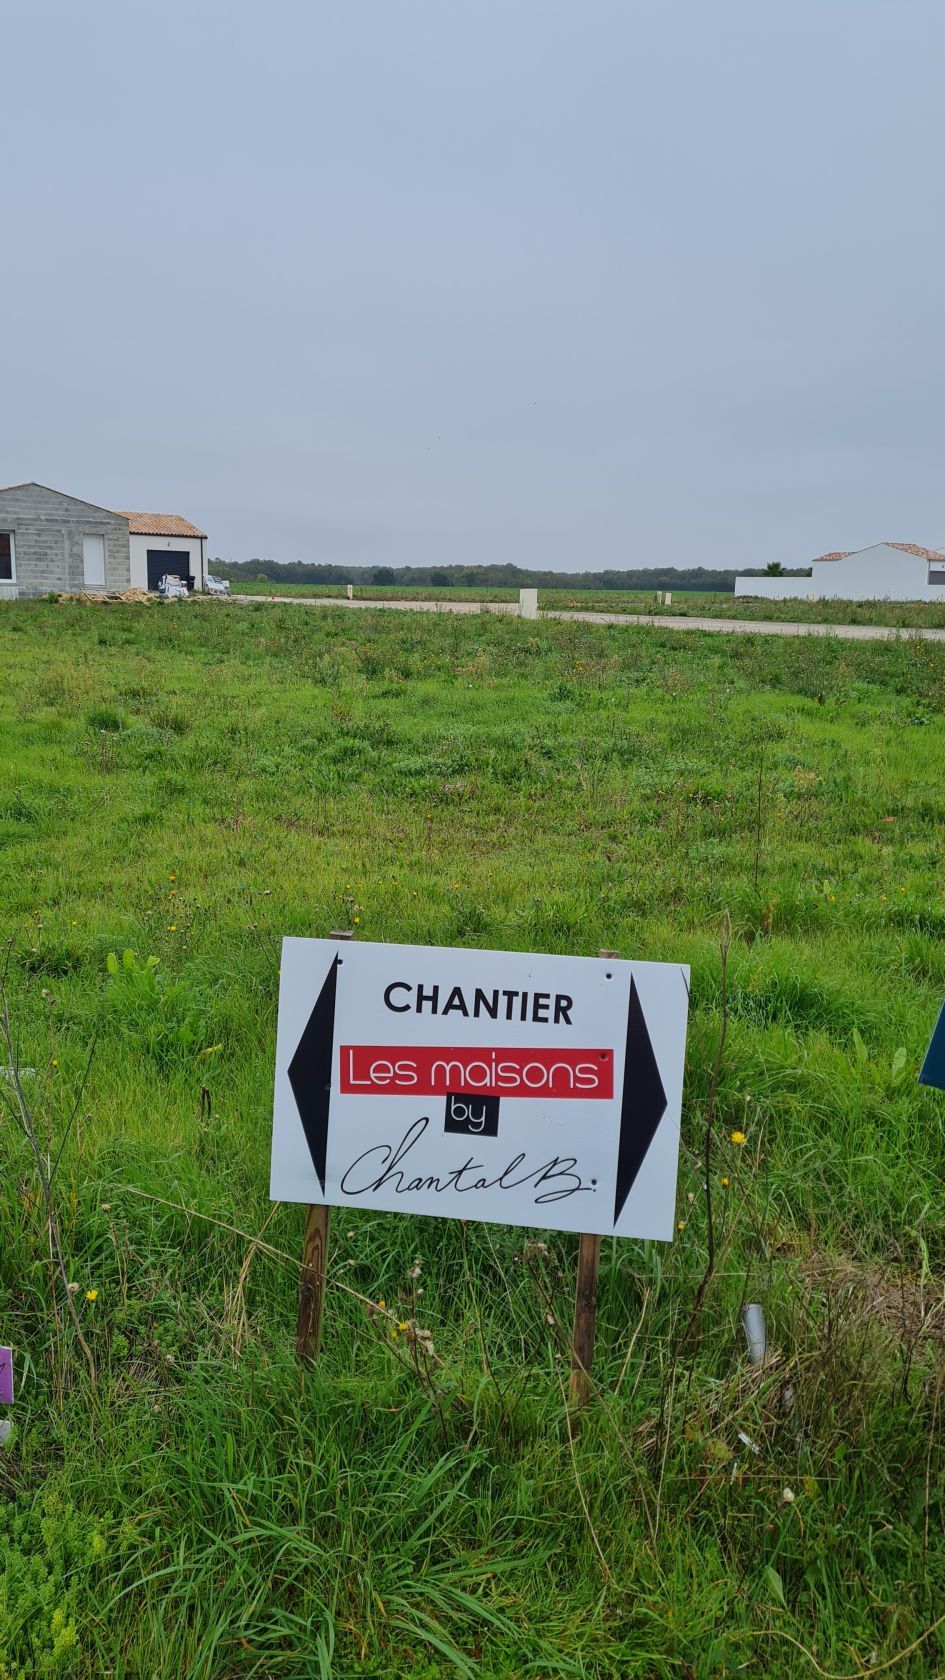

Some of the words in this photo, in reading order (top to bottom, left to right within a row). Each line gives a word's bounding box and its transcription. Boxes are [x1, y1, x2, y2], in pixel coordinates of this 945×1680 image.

[383, 981, 573, 1025] CHANTIER
[349, 1050, 418, 1085] Les
[431, 1052, 599, 1088] maisons
[451, 1095, 485, 1132] by
[340, 1116, 527, 1195] Chantal
